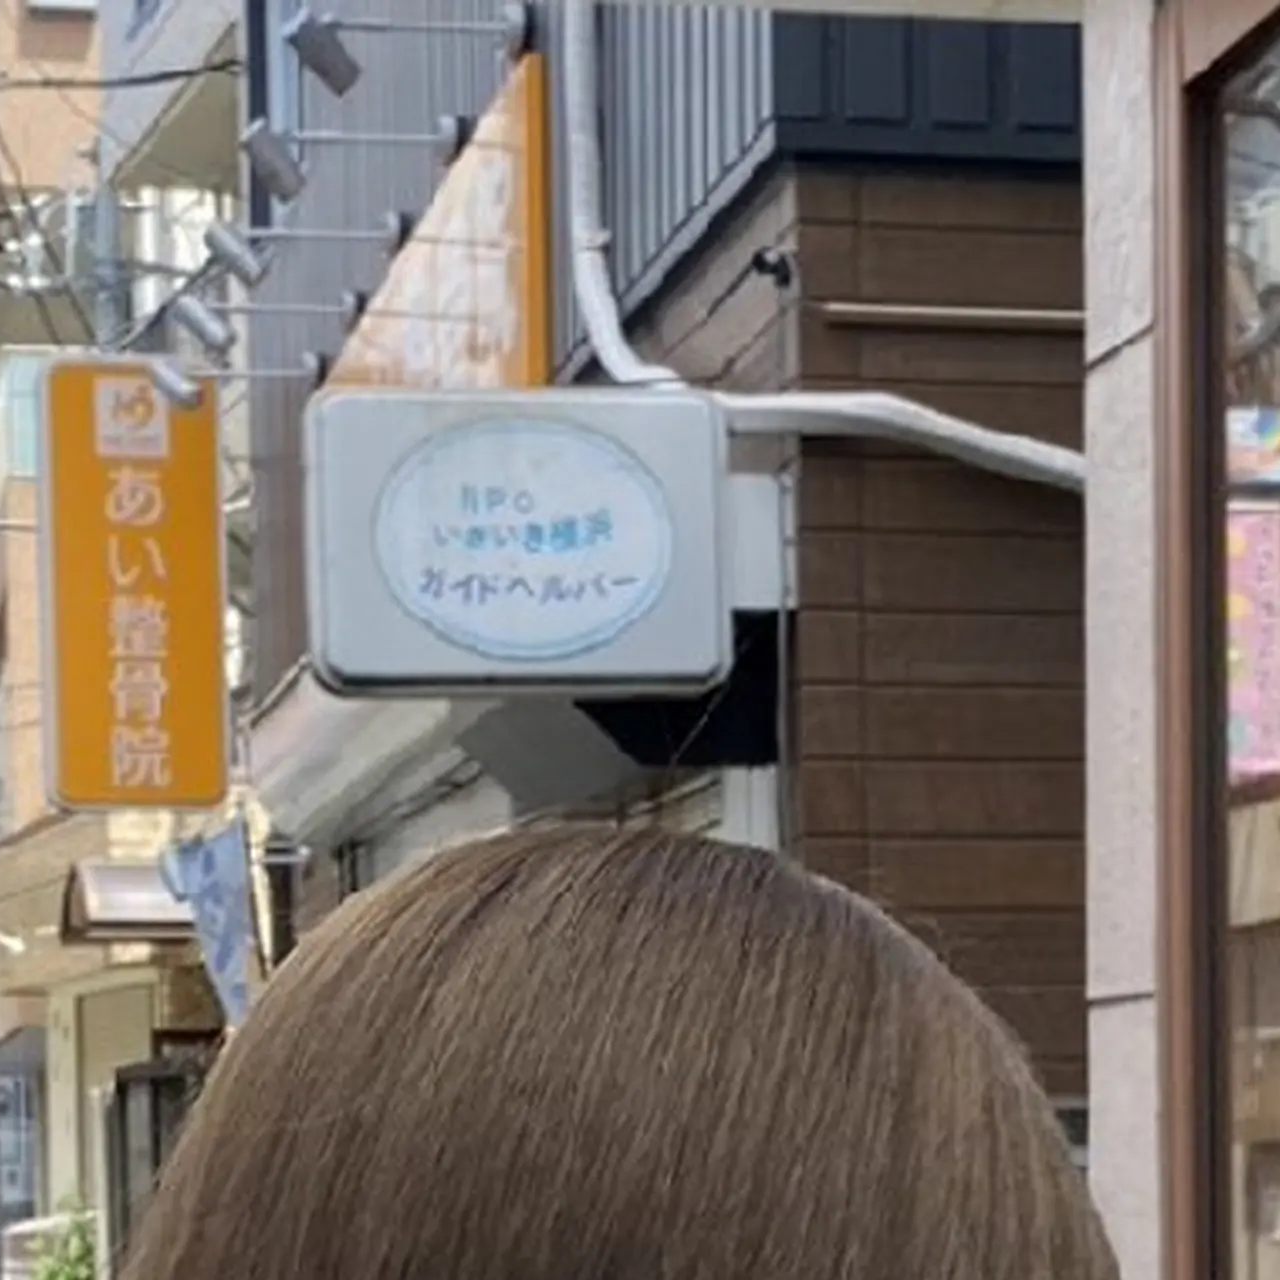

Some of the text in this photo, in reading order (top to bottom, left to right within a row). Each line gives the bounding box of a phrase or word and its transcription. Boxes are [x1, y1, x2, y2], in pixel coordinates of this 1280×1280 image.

[105, 465, 171, 788] あい整骨院
